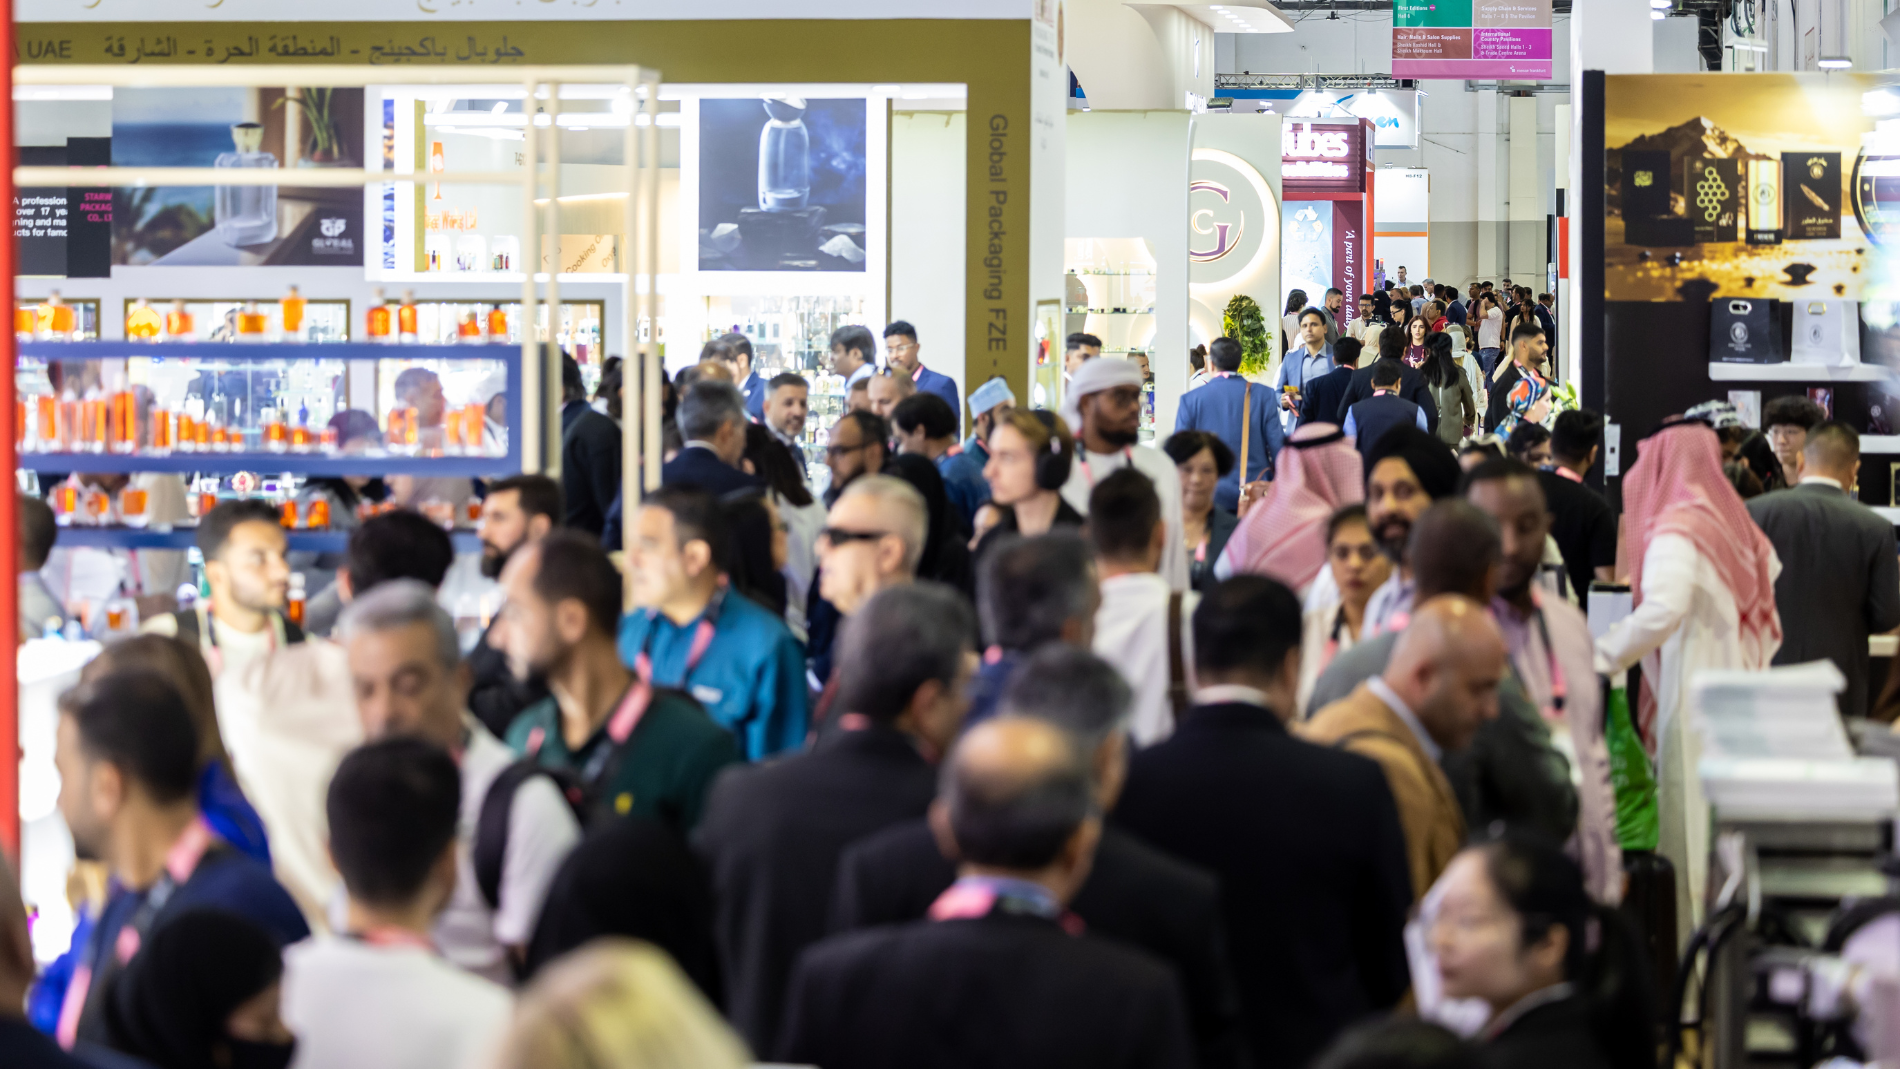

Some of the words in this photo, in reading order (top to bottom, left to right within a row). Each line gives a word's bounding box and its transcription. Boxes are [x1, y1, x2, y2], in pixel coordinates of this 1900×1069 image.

[28, 40, 72, 59] UAE
[104, 36, 178, 64] الشارقة
[205, 36, 259, 63] الحرة
[268, 35, 341, 58] المنطقة
[369, 36, 448, 65] باكجينج
[456, 36, 526, 64] جلوبال
[988, 114, 1009, 182] Global
[22, 196, 68, 206] profession
[41, 207, 50, 215] 17
[32, 228, 45, 236] for
[35, 218, 51, 226] and
[983, 190, 1008, 300] Packaging
[1344, 241, 1354, 263] part
[1344, 265, 1355, 278] of
[1344, 278, 1352, 303] your
[987, 308, 1008, 351] FZE
